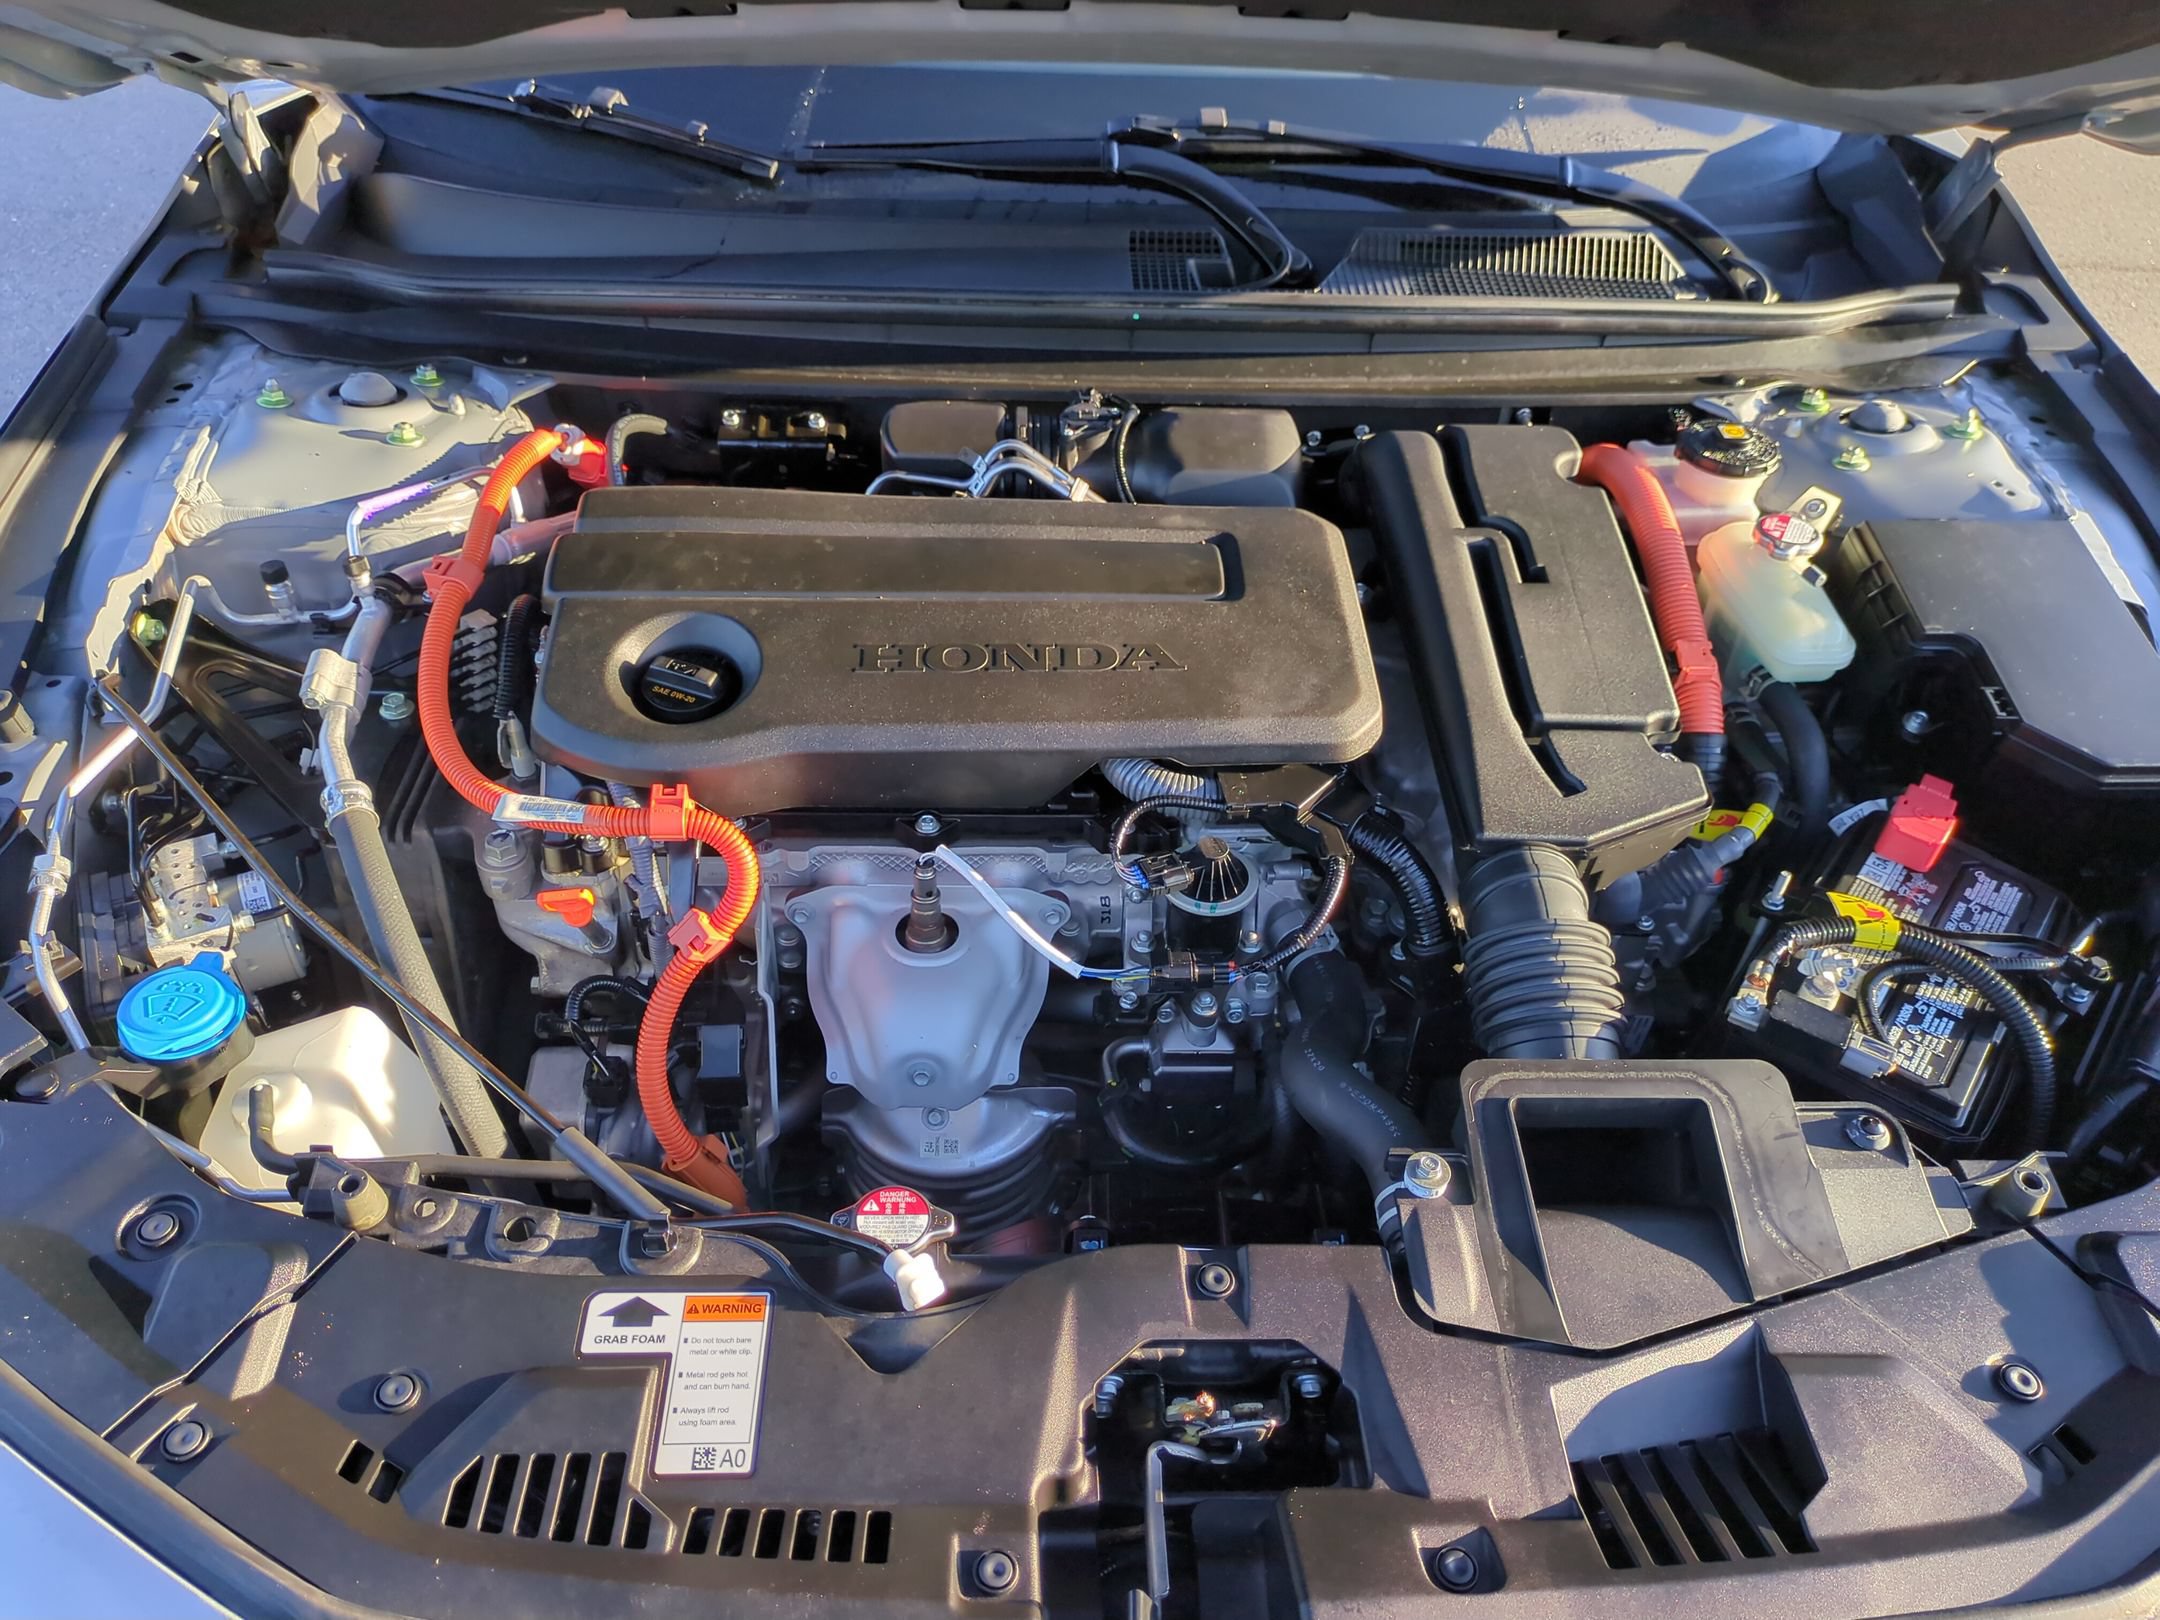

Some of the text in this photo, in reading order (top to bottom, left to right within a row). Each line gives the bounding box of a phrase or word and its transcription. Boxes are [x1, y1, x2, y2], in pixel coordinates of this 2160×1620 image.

[850, 642, 1188, 673] HONDA
[652, 685, 696, 704] SAE 0W-20
[1100, 895, 1112, 924] 318
[702, 1303, 762, 1314] WARNING
[594, 1334, 666, 1344] GRAB FOAM
[720, 1371, 735, 1379] gets
[680, 1407, 705, 1415] Always
[678, 1419, 698, 1427] using
[719, 1448, 746, 1468] A0
